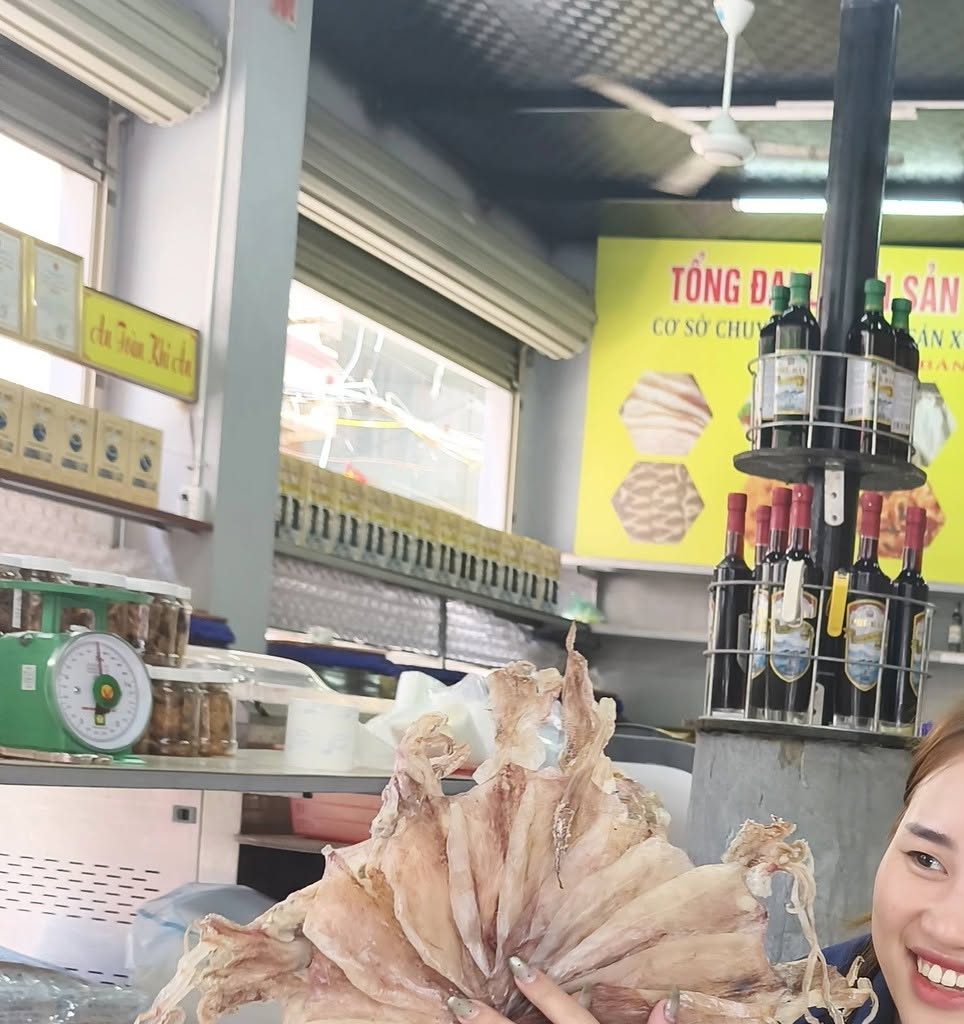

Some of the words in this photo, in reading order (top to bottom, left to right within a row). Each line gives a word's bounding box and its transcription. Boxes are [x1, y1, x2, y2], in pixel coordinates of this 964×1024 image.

[672, 252, 740, 305] TỔNG
[903, 262, 960, 314] SẢN
[653, 316, 680, 337] CƠ
